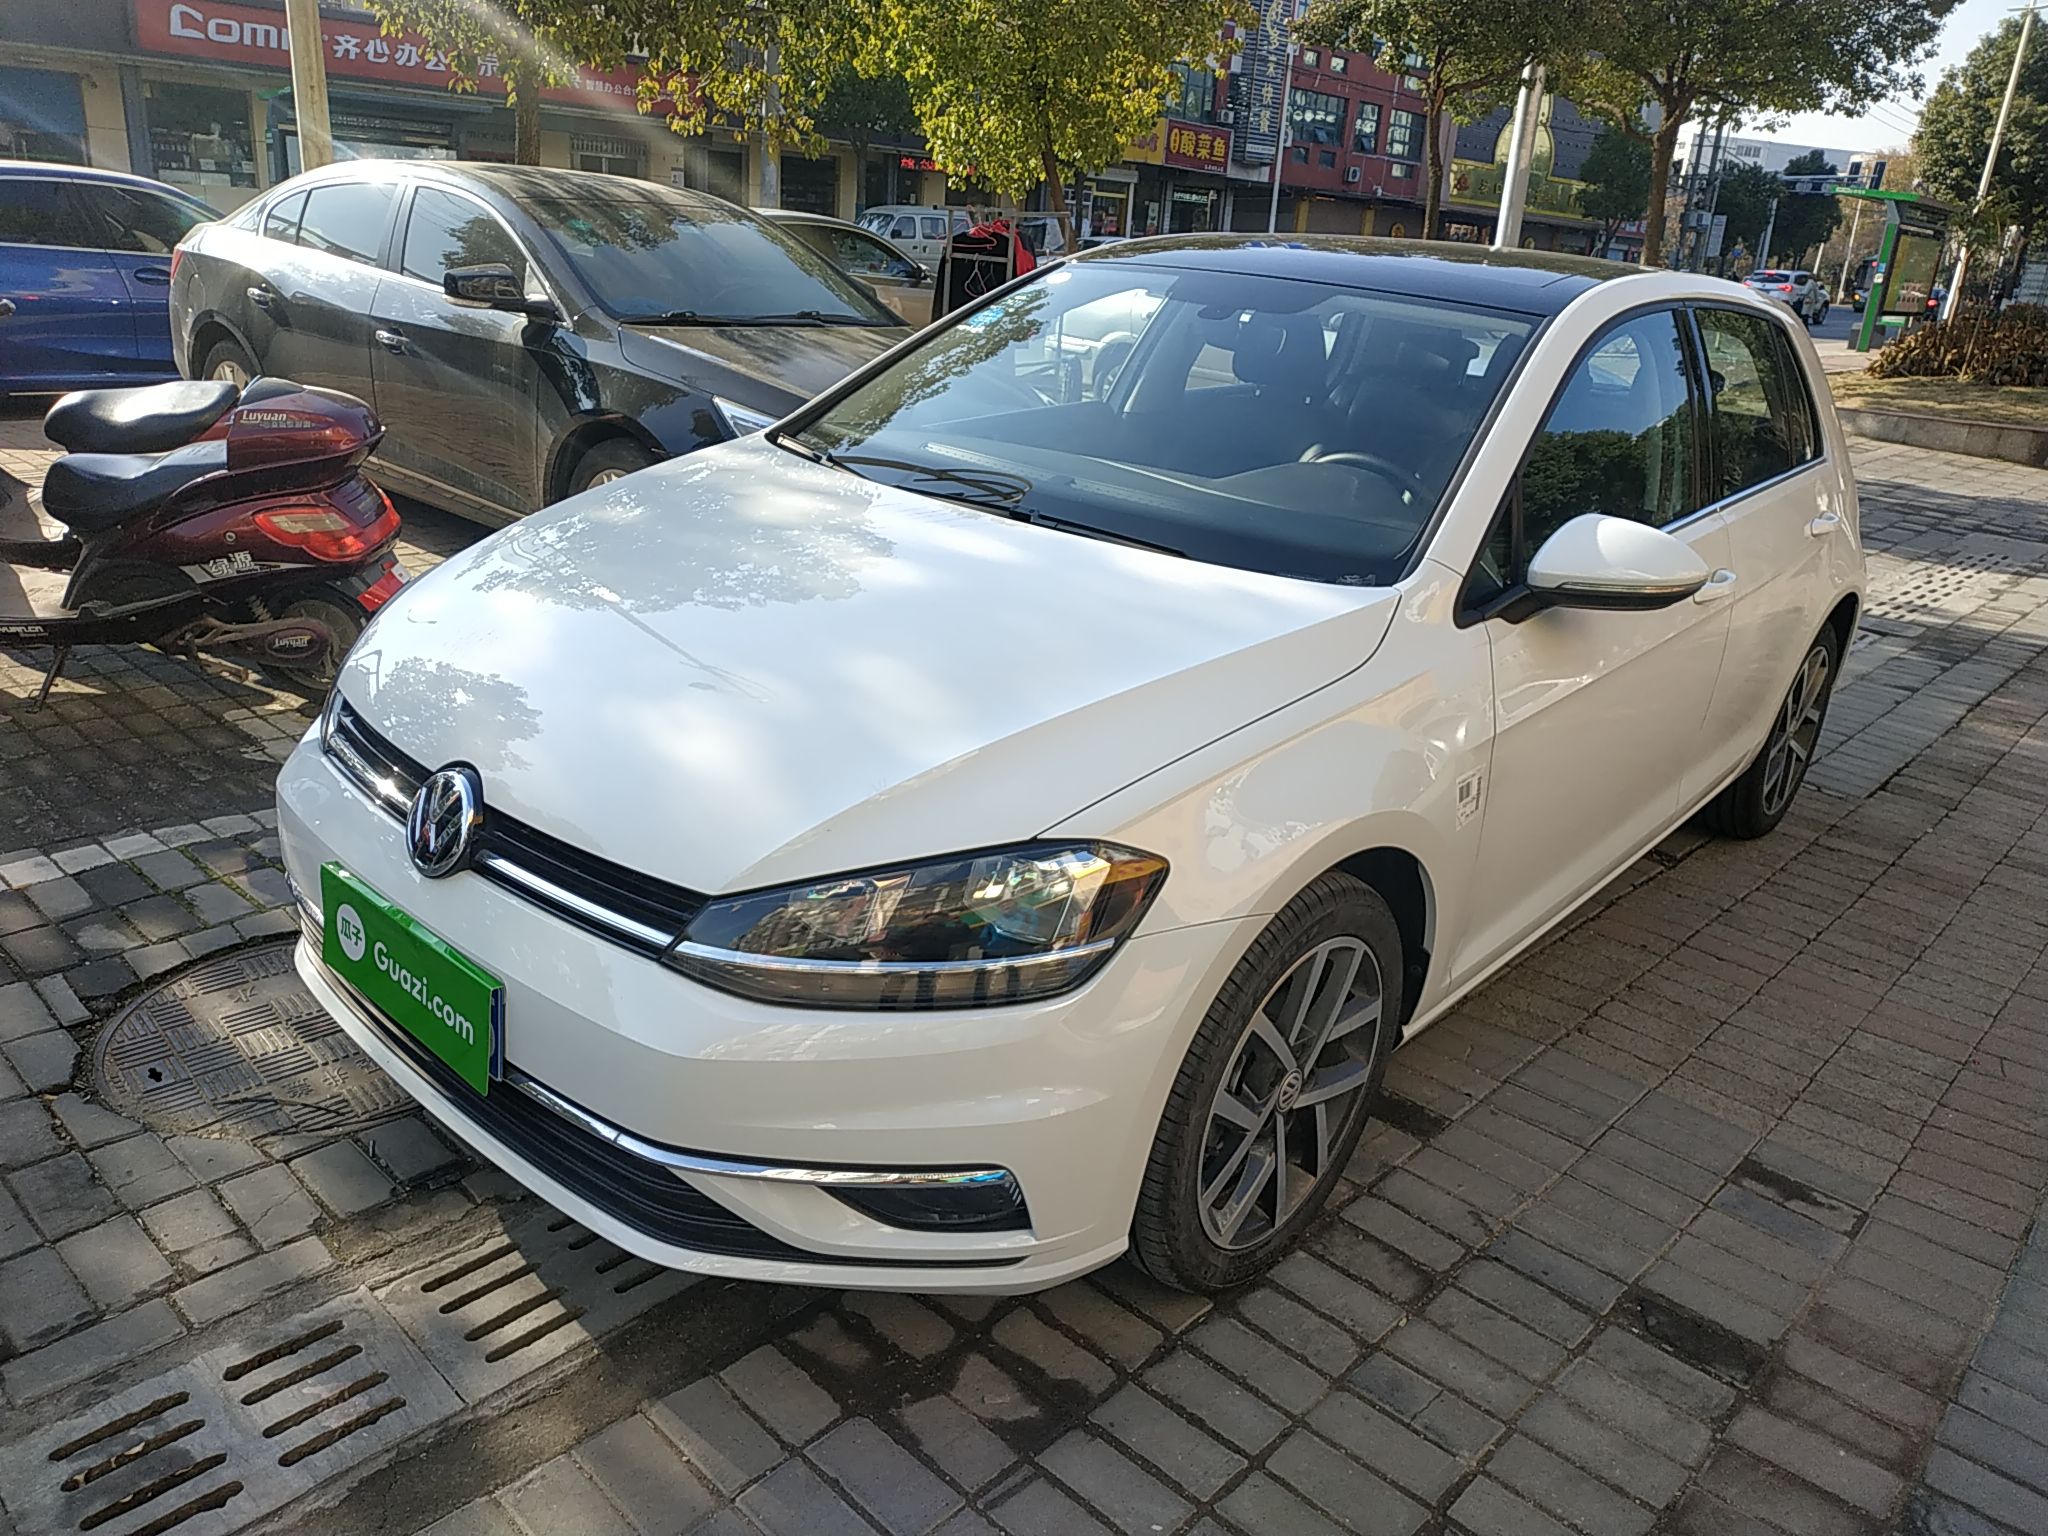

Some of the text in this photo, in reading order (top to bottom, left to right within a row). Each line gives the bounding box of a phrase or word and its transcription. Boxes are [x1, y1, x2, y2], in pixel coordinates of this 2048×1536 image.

[1180, 130, 1226, 162] 酸菜鱼
[242, 410, 287, 424] Luyuan
[340, 917, 363, 949] 瓜子
[374, 941, 474, 1045] Guazi.com
